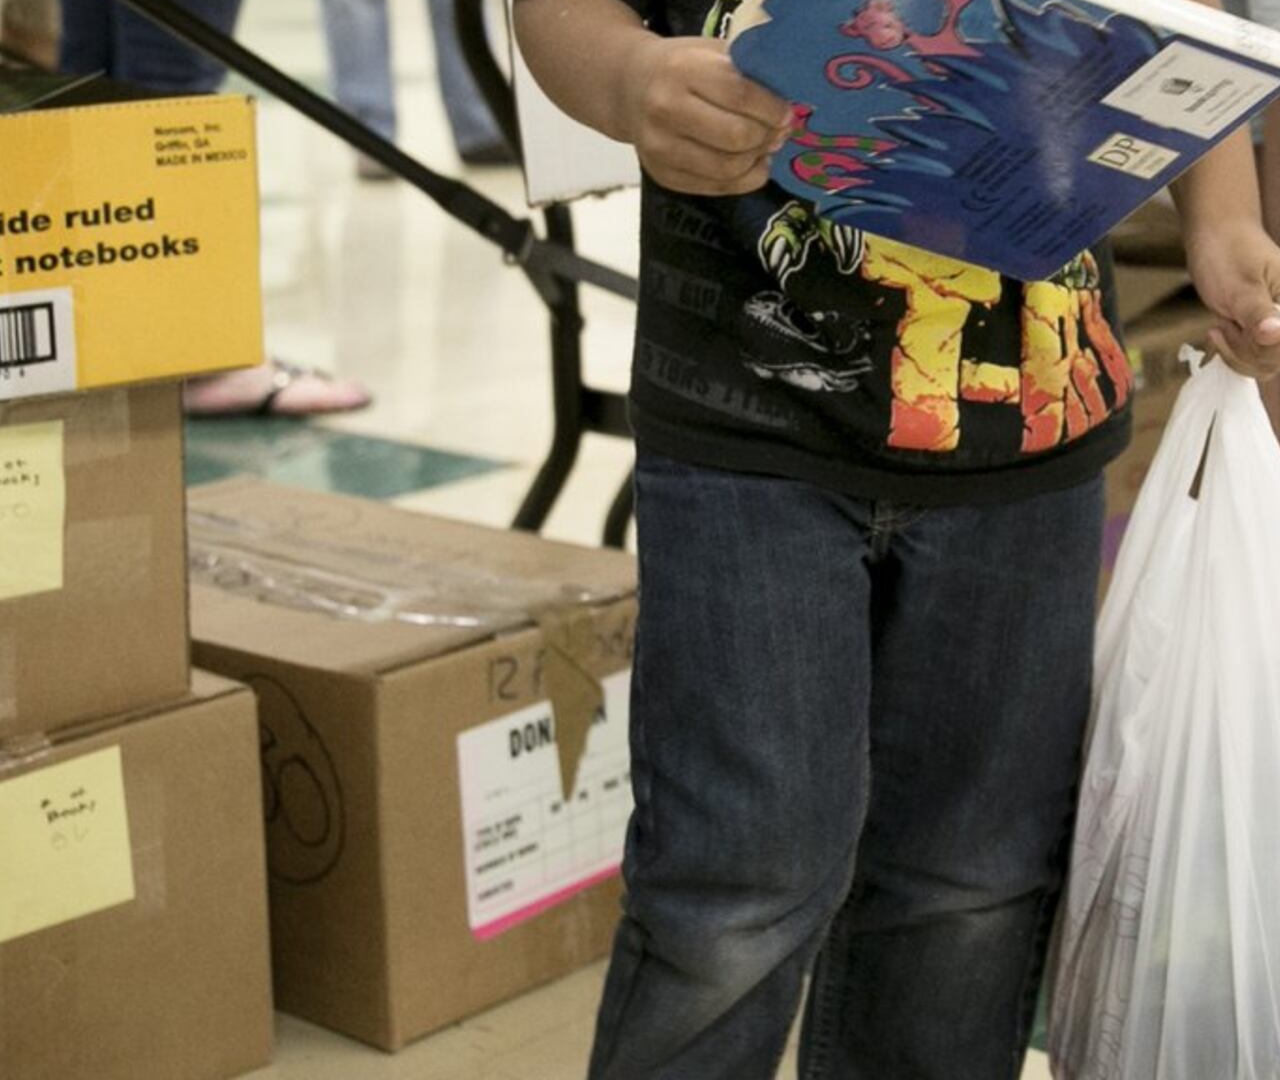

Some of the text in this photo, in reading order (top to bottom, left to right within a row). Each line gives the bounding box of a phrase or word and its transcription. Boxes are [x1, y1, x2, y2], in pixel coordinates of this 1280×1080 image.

[156, 150, 247, 167] MADE IN MEXICO
[1096, 137, 1141, 167] DP
[65, 198, 156, 229] ruled
[15, 235, 200, 275] notebooks
